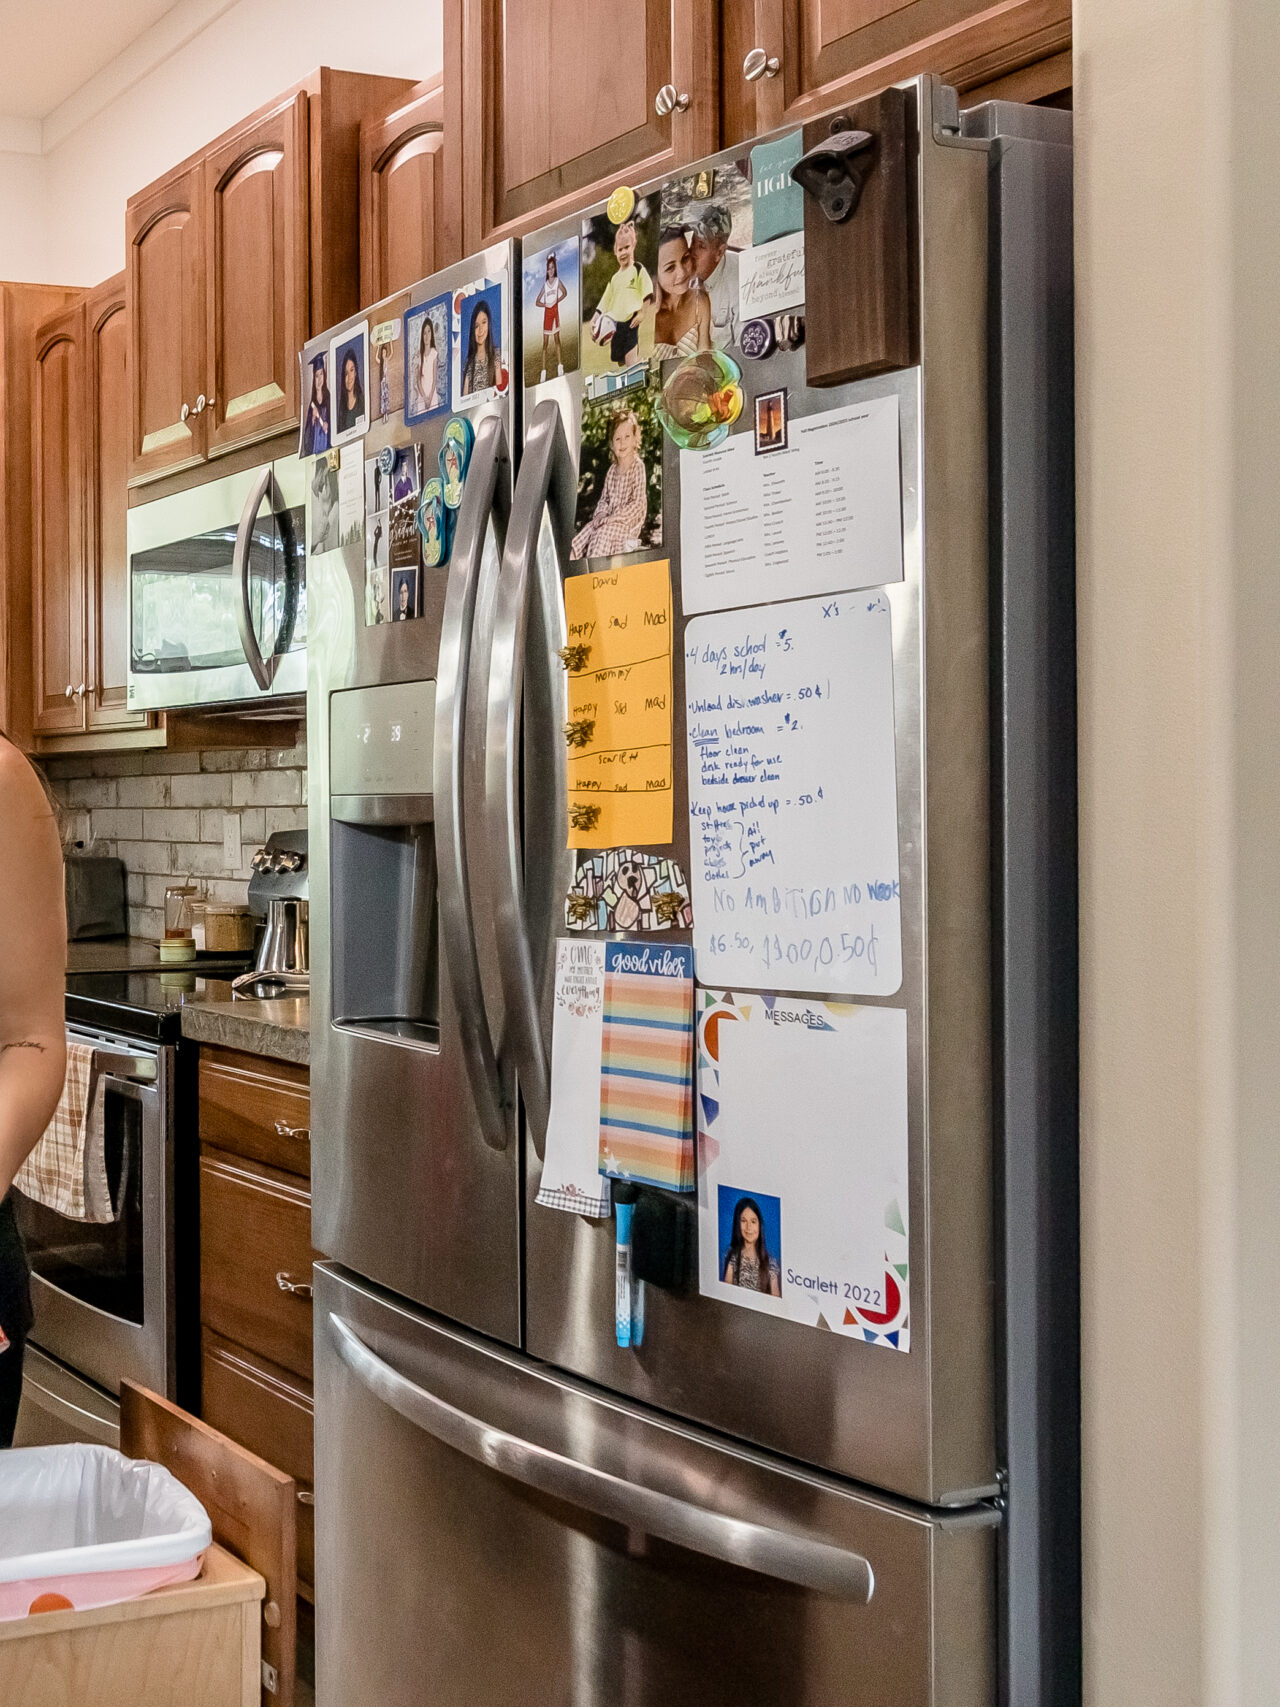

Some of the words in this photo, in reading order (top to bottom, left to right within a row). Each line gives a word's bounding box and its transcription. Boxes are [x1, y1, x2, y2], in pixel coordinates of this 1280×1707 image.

[592, 574, 619, 590] David
[569, 621, 596, 639] Happy
[644, 609, 667, 626] Mad
[702, 643, 727, 670] days
[733, 634, 768, 657] school
[573, 703, 598, 718] Happy
[645, 694, 666, 711] Mad
[691, 694, 722, 714] Unload
[724, 720, 765, 739] bedroom
[700, 746, 722, 760] floor
[725, 744, 749, 757] clean
[725, 756, 748, 773] ready
[760, 768, 780, 782] clean
[576, 779, 601, 790] Happy
[646, 778, 666, 790] Mad
[768, 799, 779, 815] up
[764, 1009, 825, 1026] MESSAGES
[787, 1268, 838, 1295] Scarlett
[843, 1283, 881, 1306] 2022
